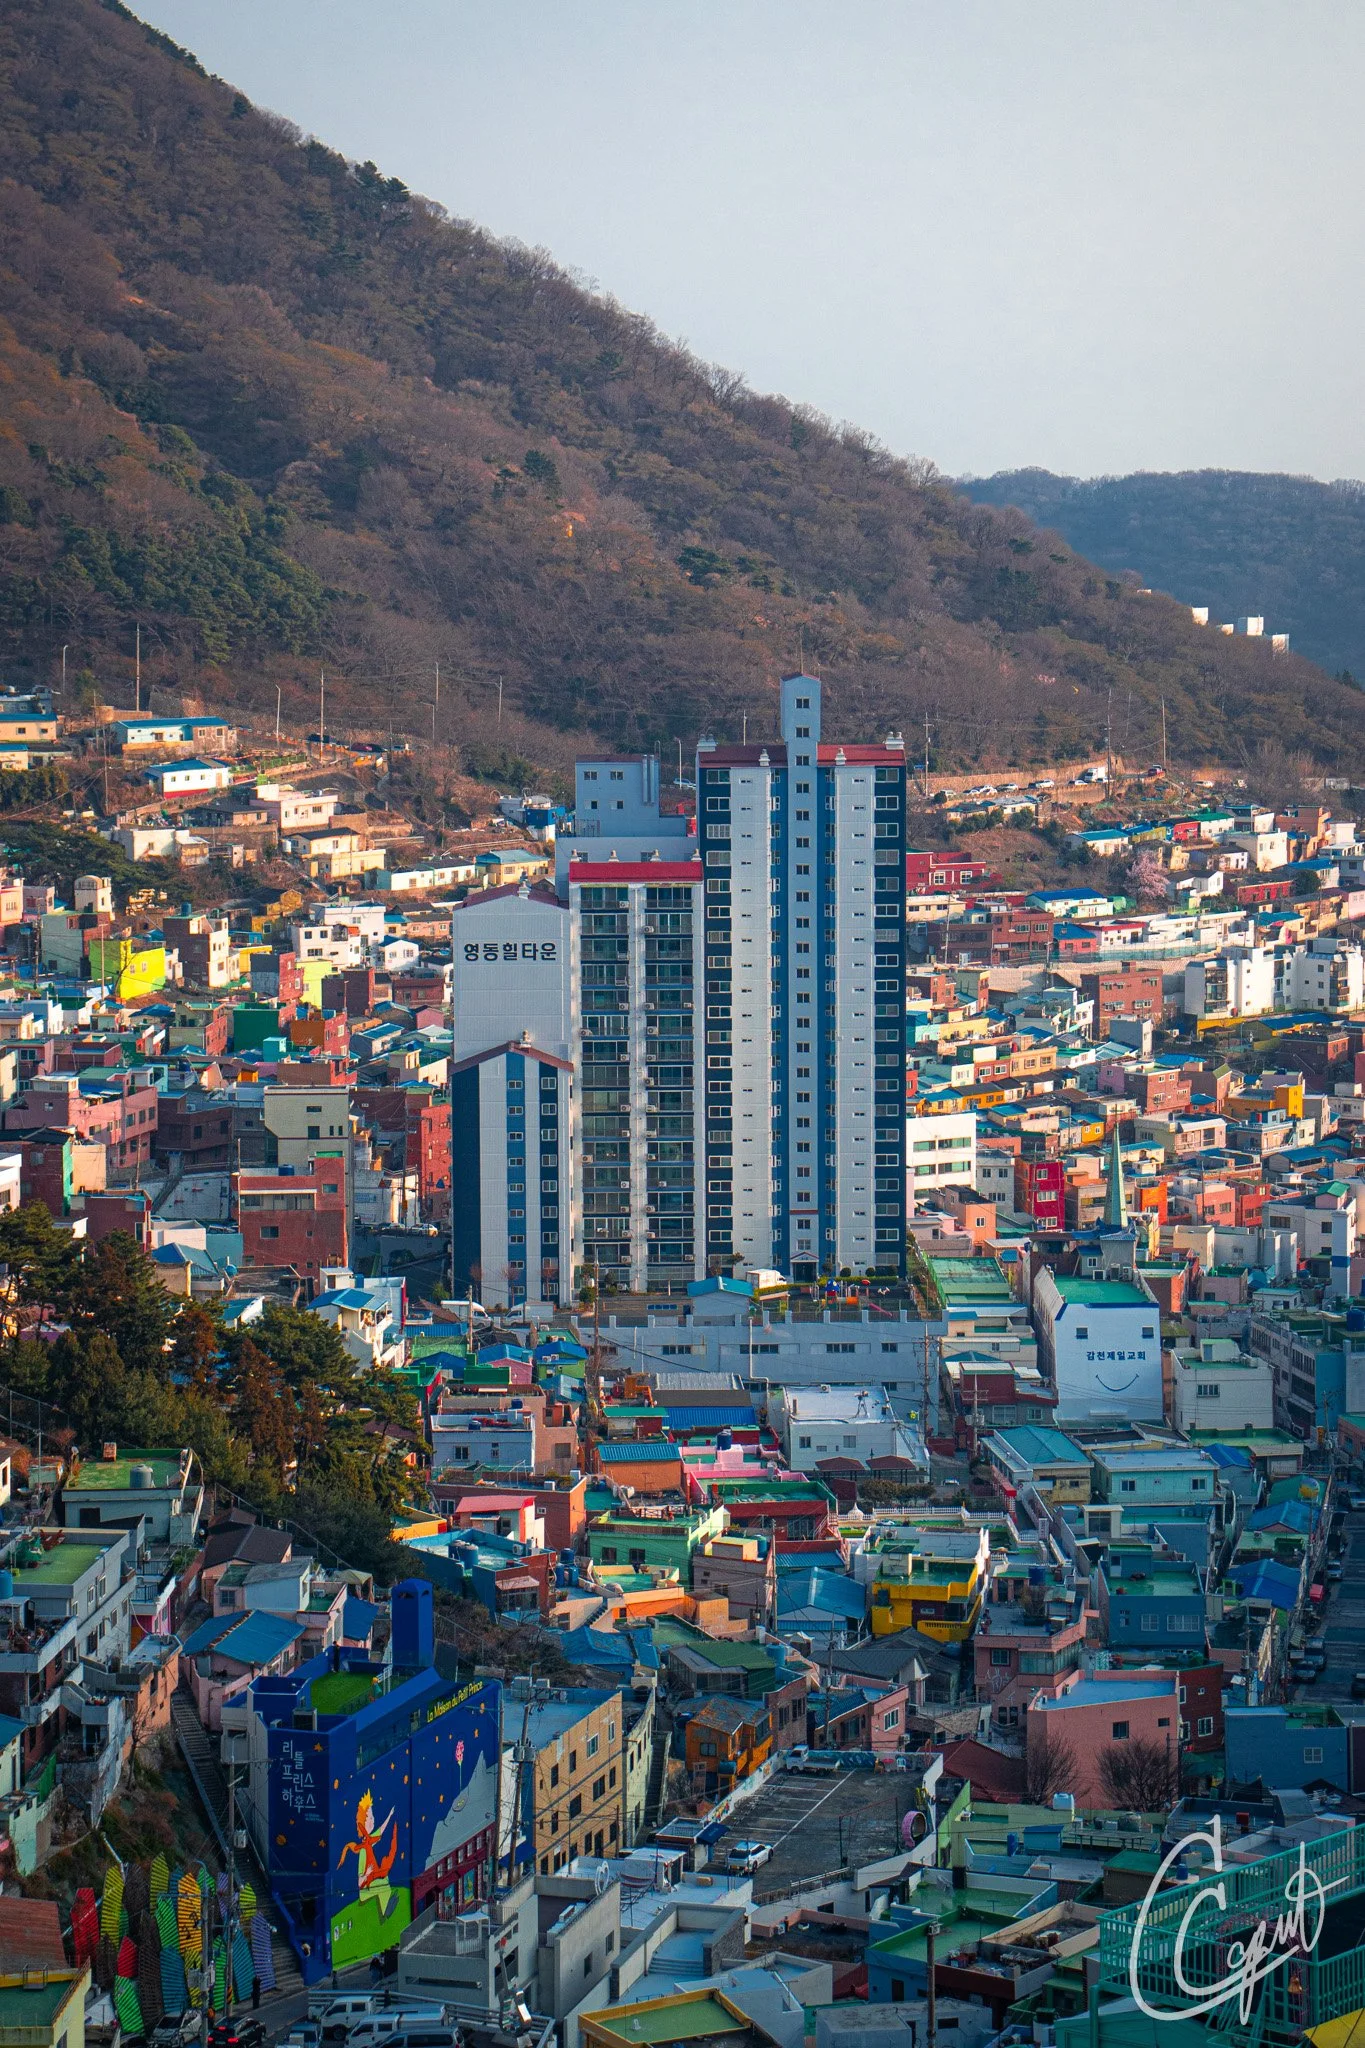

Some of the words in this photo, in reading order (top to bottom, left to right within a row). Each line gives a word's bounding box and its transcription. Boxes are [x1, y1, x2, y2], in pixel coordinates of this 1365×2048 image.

[464, 942, 557, 962] 영동힐타운
[1086, 1350, 1146, 1361] 감천제일교회
[469, 1681, 483, 1697] Prince
[282, 1740, 304, 1770] 리틀
[282, 1764, 315, 1793] 프린스
[282, 1788, 316, 1813] 하우스
